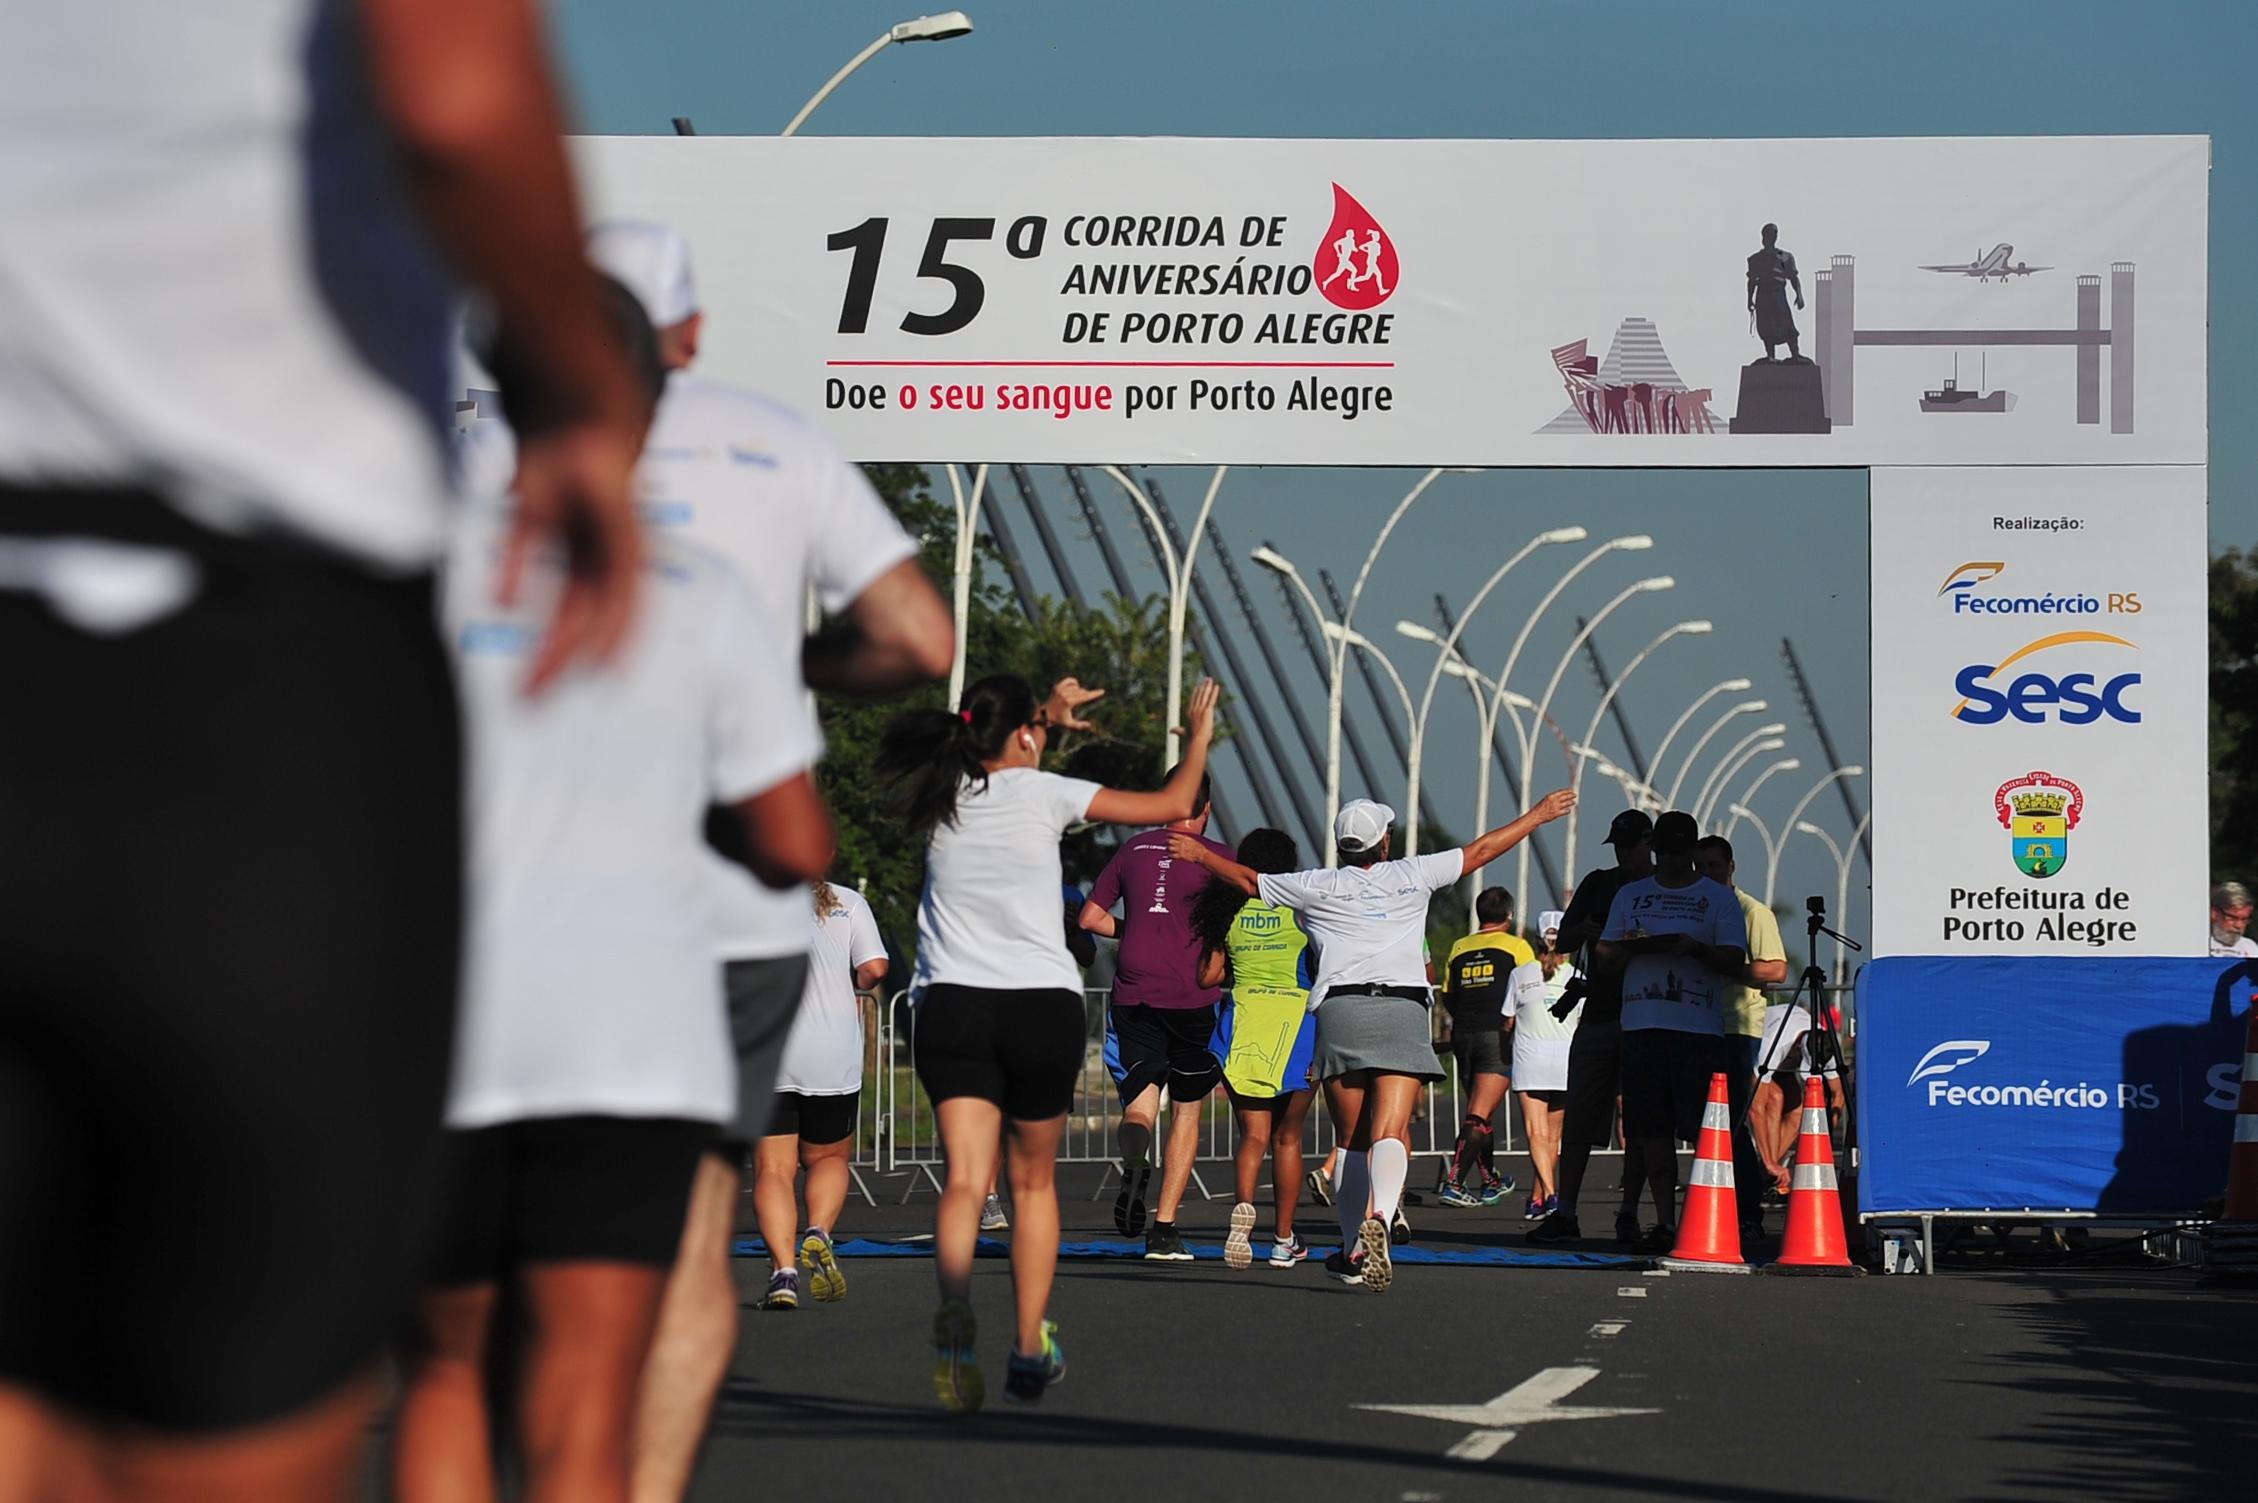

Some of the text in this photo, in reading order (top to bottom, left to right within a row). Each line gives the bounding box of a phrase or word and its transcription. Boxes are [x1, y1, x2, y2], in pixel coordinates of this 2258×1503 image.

[1063, 215, 1288, 247] CORRIDA DE
[1060, 255, 1312, 296] ANIVERSÁRIO
[1062, 312, 1395, 345] DE PORTO ALEGRE
[825, 375, 1393, 421] Doe o seu sangue por Porto Alegre
[1993, 516, 2084, 533] Realização:
[1954, 592, 2142, 614] Fecomércio RS
[1952, 664, 2142, 725] Sesc
[1950, 886, 2130, 911] Prefeitura de
[1241, 912, 1281, 929] mbm
[1943, 912, 2137, 947] Porto Alegre
[1928, 1079, 2160, 1110] Fecomércio RS
